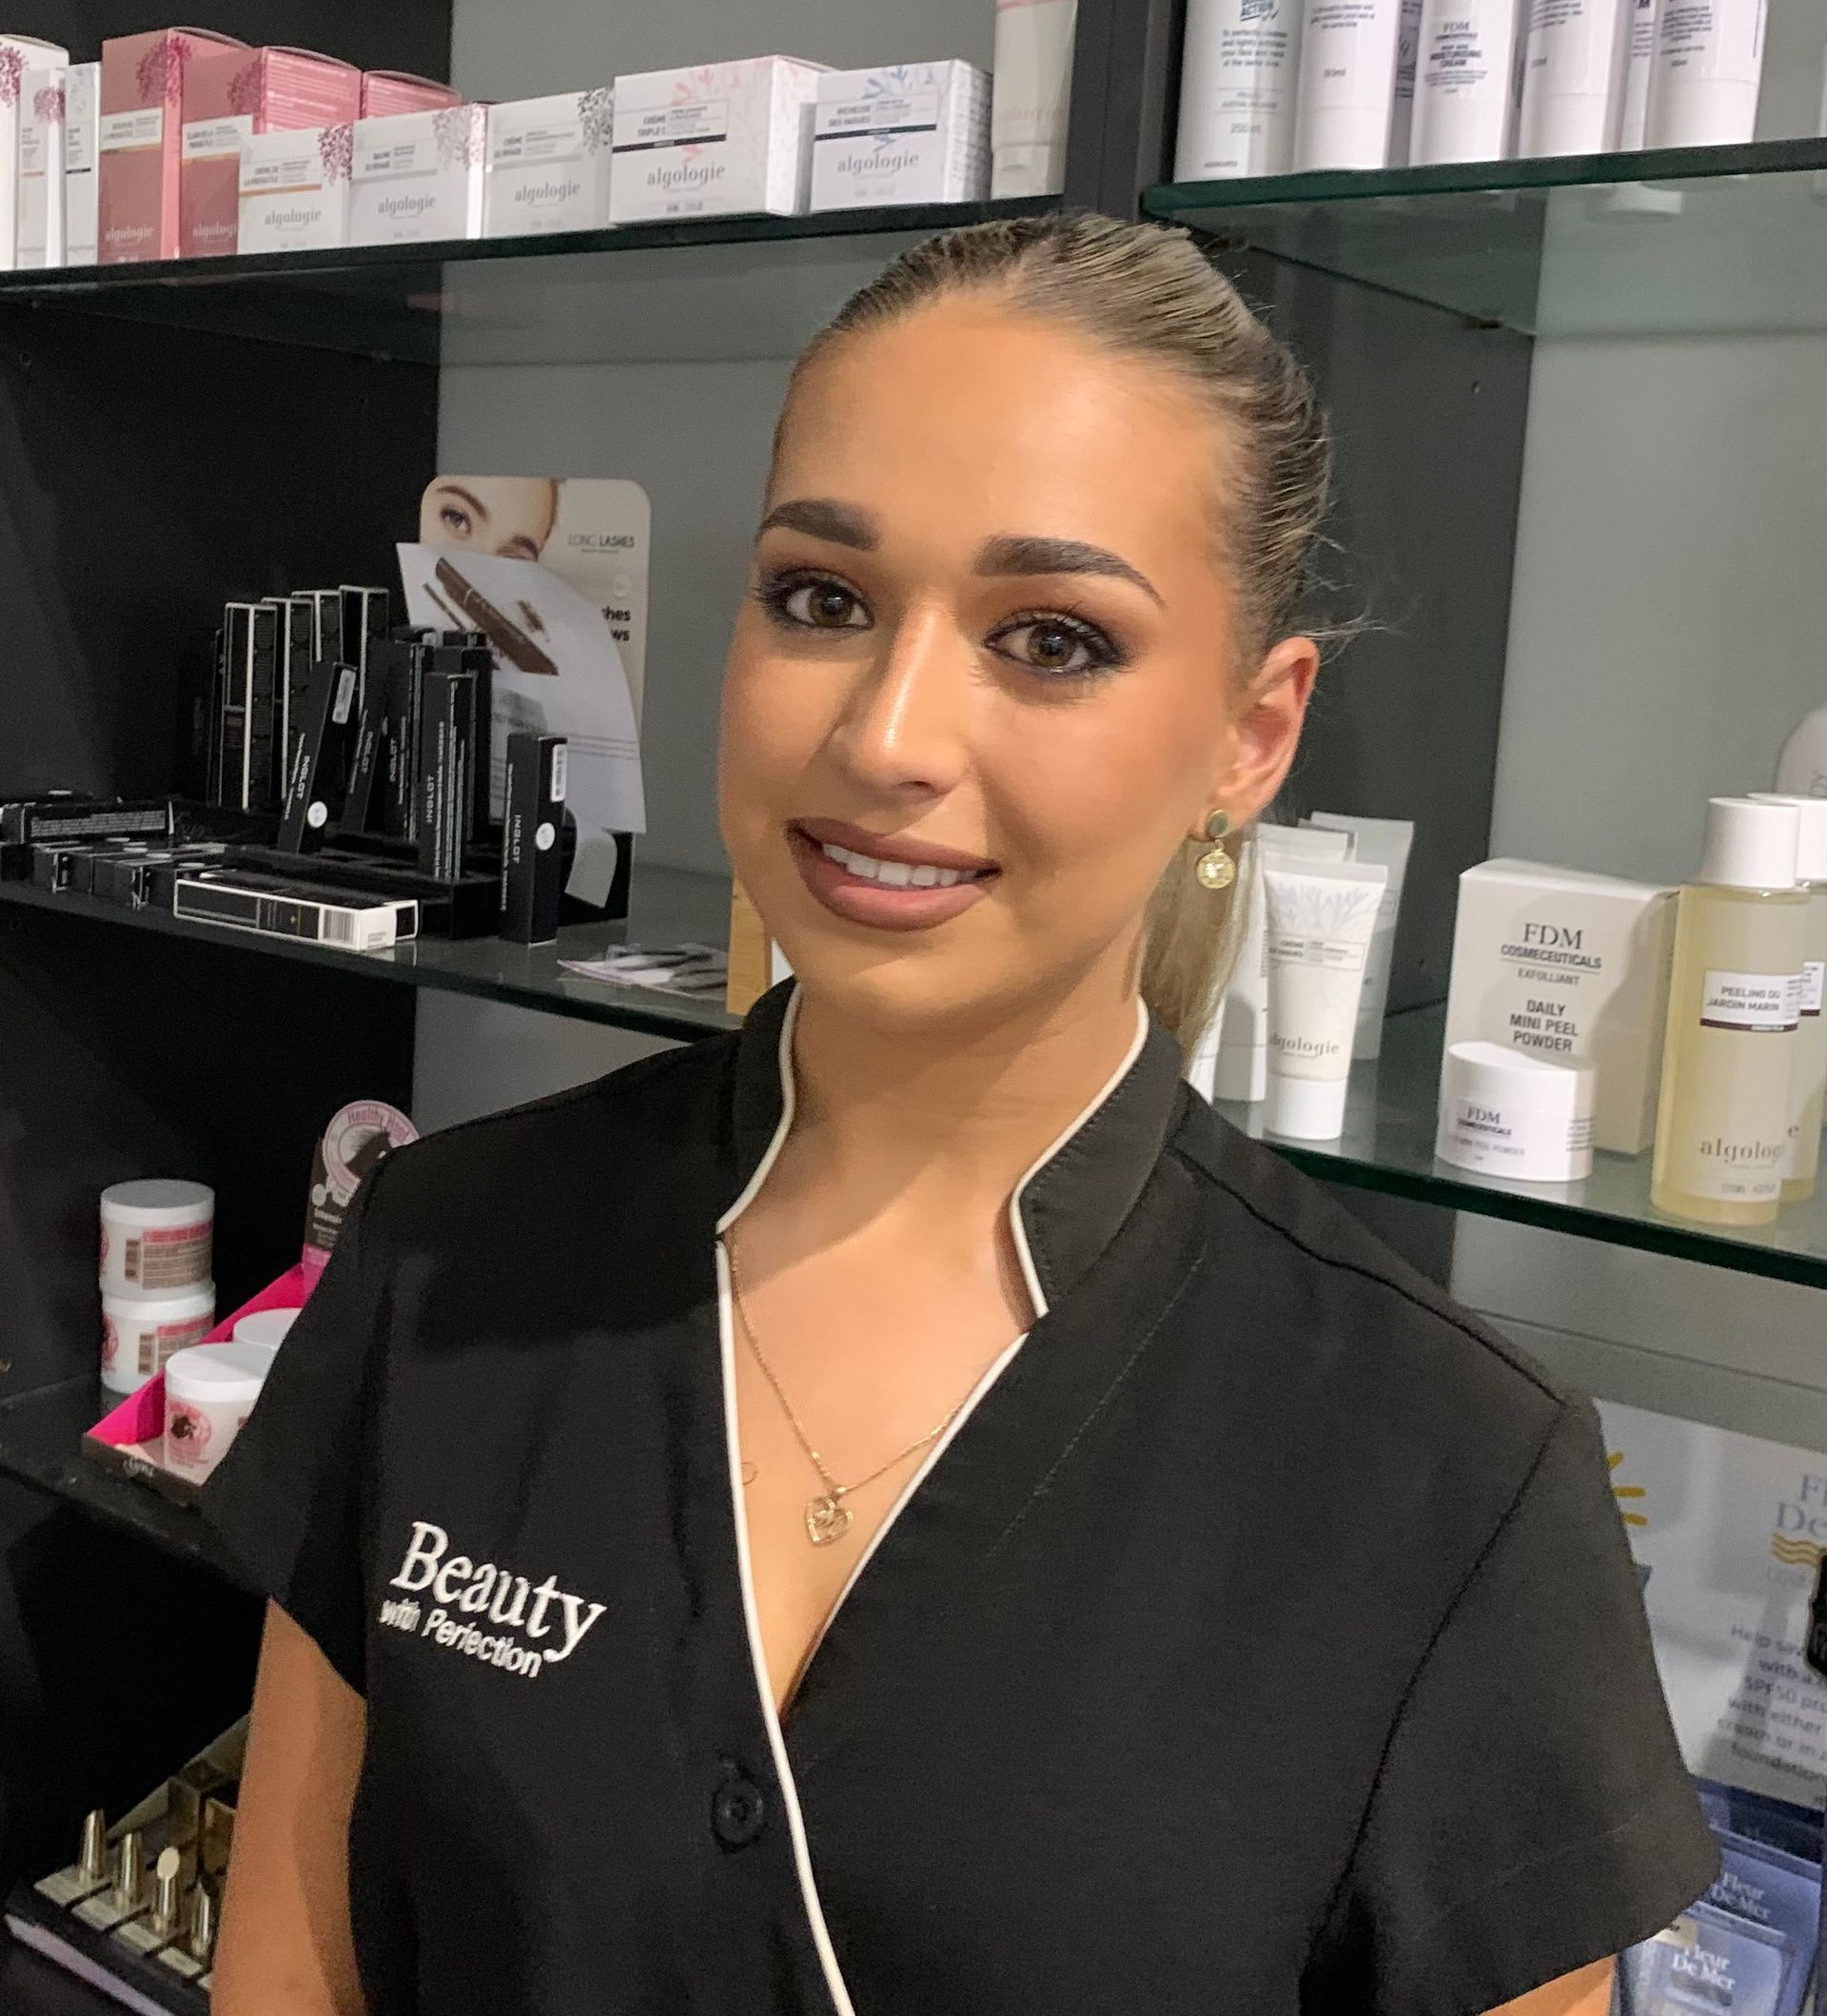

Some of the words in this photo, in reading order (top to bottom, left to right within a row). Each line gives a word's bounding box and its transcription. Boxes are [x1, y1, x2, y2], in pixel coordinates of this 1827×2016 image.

[837, 151, 919, 175] algologie
[647, 162, 725, 189] algologie
[514, 179, 581, 203] algologie
[378, 192, 436, 215] algologie
[265, 206, 322, 227] algologie
[105, 224, 154, 245] algologie
[192, 220, 238, 242] algologi
[599, 534, 636, 549] LASHES
[426, 773, 436, 824] INGLOT
[513, 813, 522, 865] INGLOT
[1522, 922, 1584, 950] FDM
[1501, 944, 1603, 969] COSMECEUTICALS
[1706, 997, 1746, 1010] JARDIN
[1719, 986, 1767, 999] PEELING
[1767, 988, 1781, 999] DU
[1526, 999, 1566, 1017] DAILY
[1509, 1013, 1542, 1030] MINI
[1545, 1019, 1580, 1037] PEEL
[1513, 1029, 1573, 1052] POWDER
[1466, 1106, 1501, 1125] FDM
[1699, 1138, 1782, 1163] algolog
[389, 1520, 608, 1664] Beauty
[380, 1597, 422, 1633] with
[421, 1608, 543, 1678] Perfection
[1671, 1952, 1699, 1977] De
